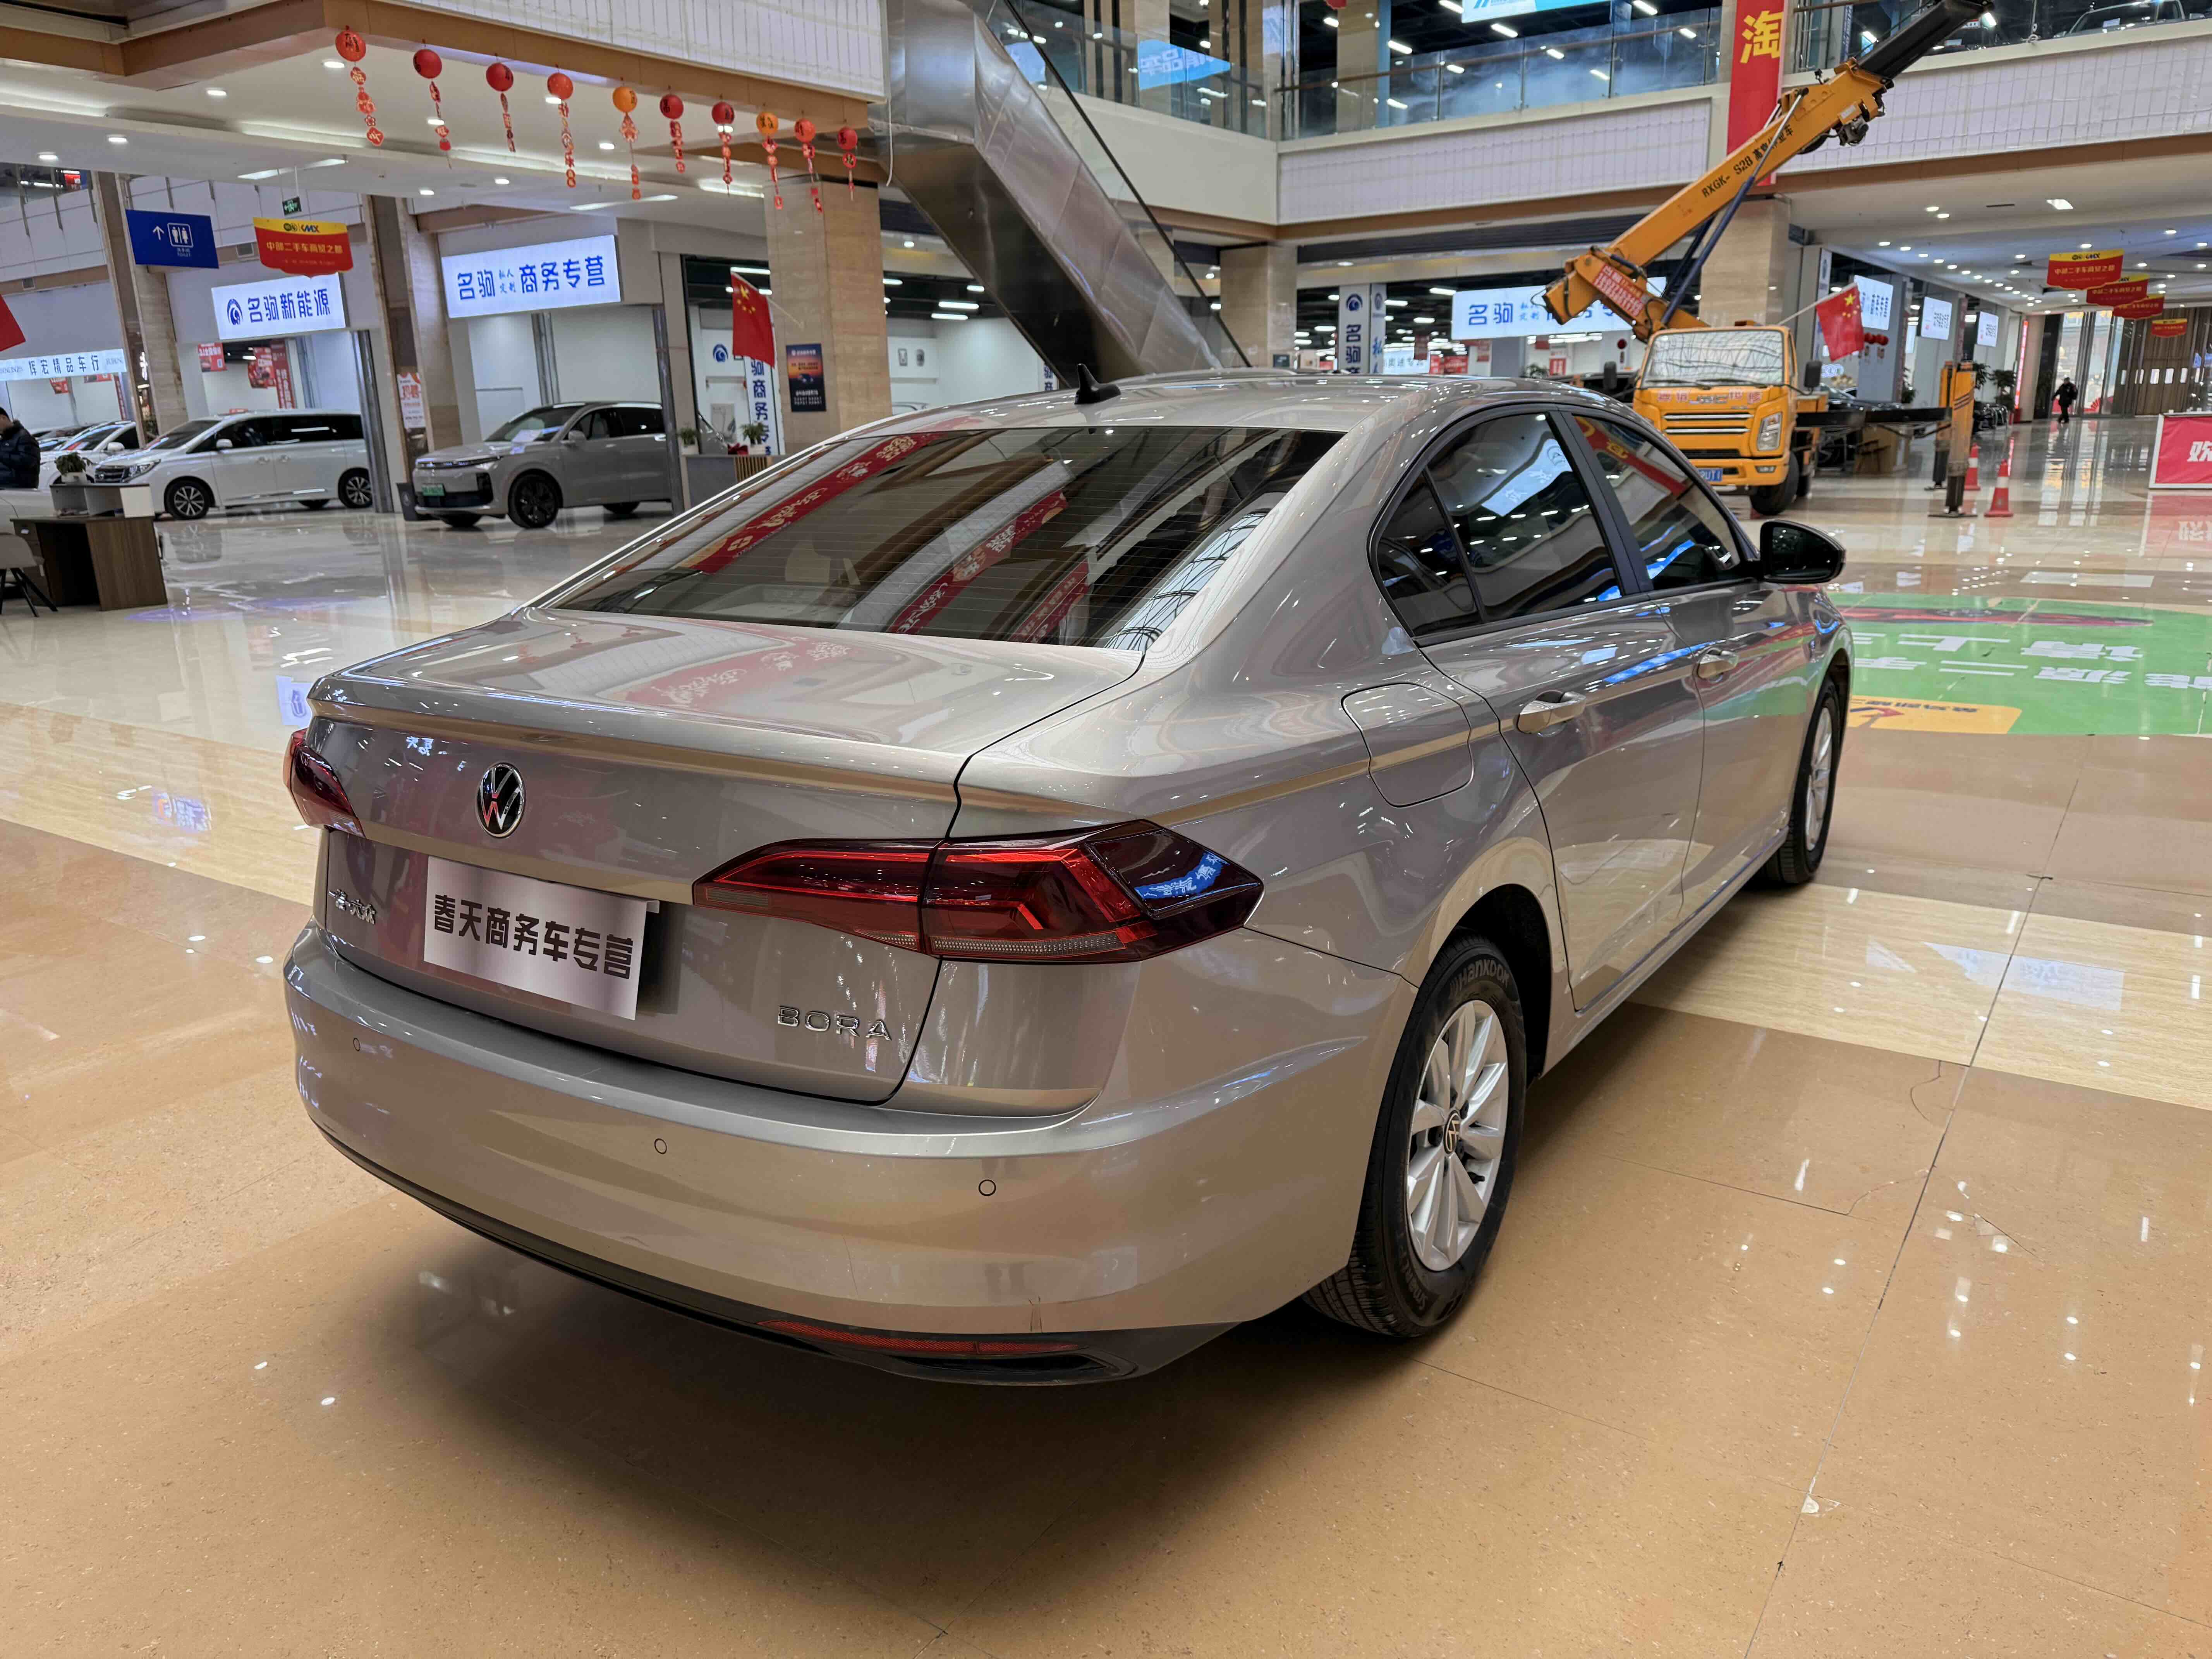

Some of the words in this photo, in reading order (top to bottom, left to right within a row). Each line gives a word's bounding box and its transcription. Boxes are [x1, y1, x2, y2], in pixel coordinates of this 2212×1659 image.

[1740, 10, 1783, 64] 淘
[519, 255, 606, 294] 商务专营
[247, 288, 331, 324] 名驹新能源
[1346, 324, 1362, 373] 名驹
[434, 894, 633, 980] 春天商务车专营
[777, 1005, 892, 1041] BORA
